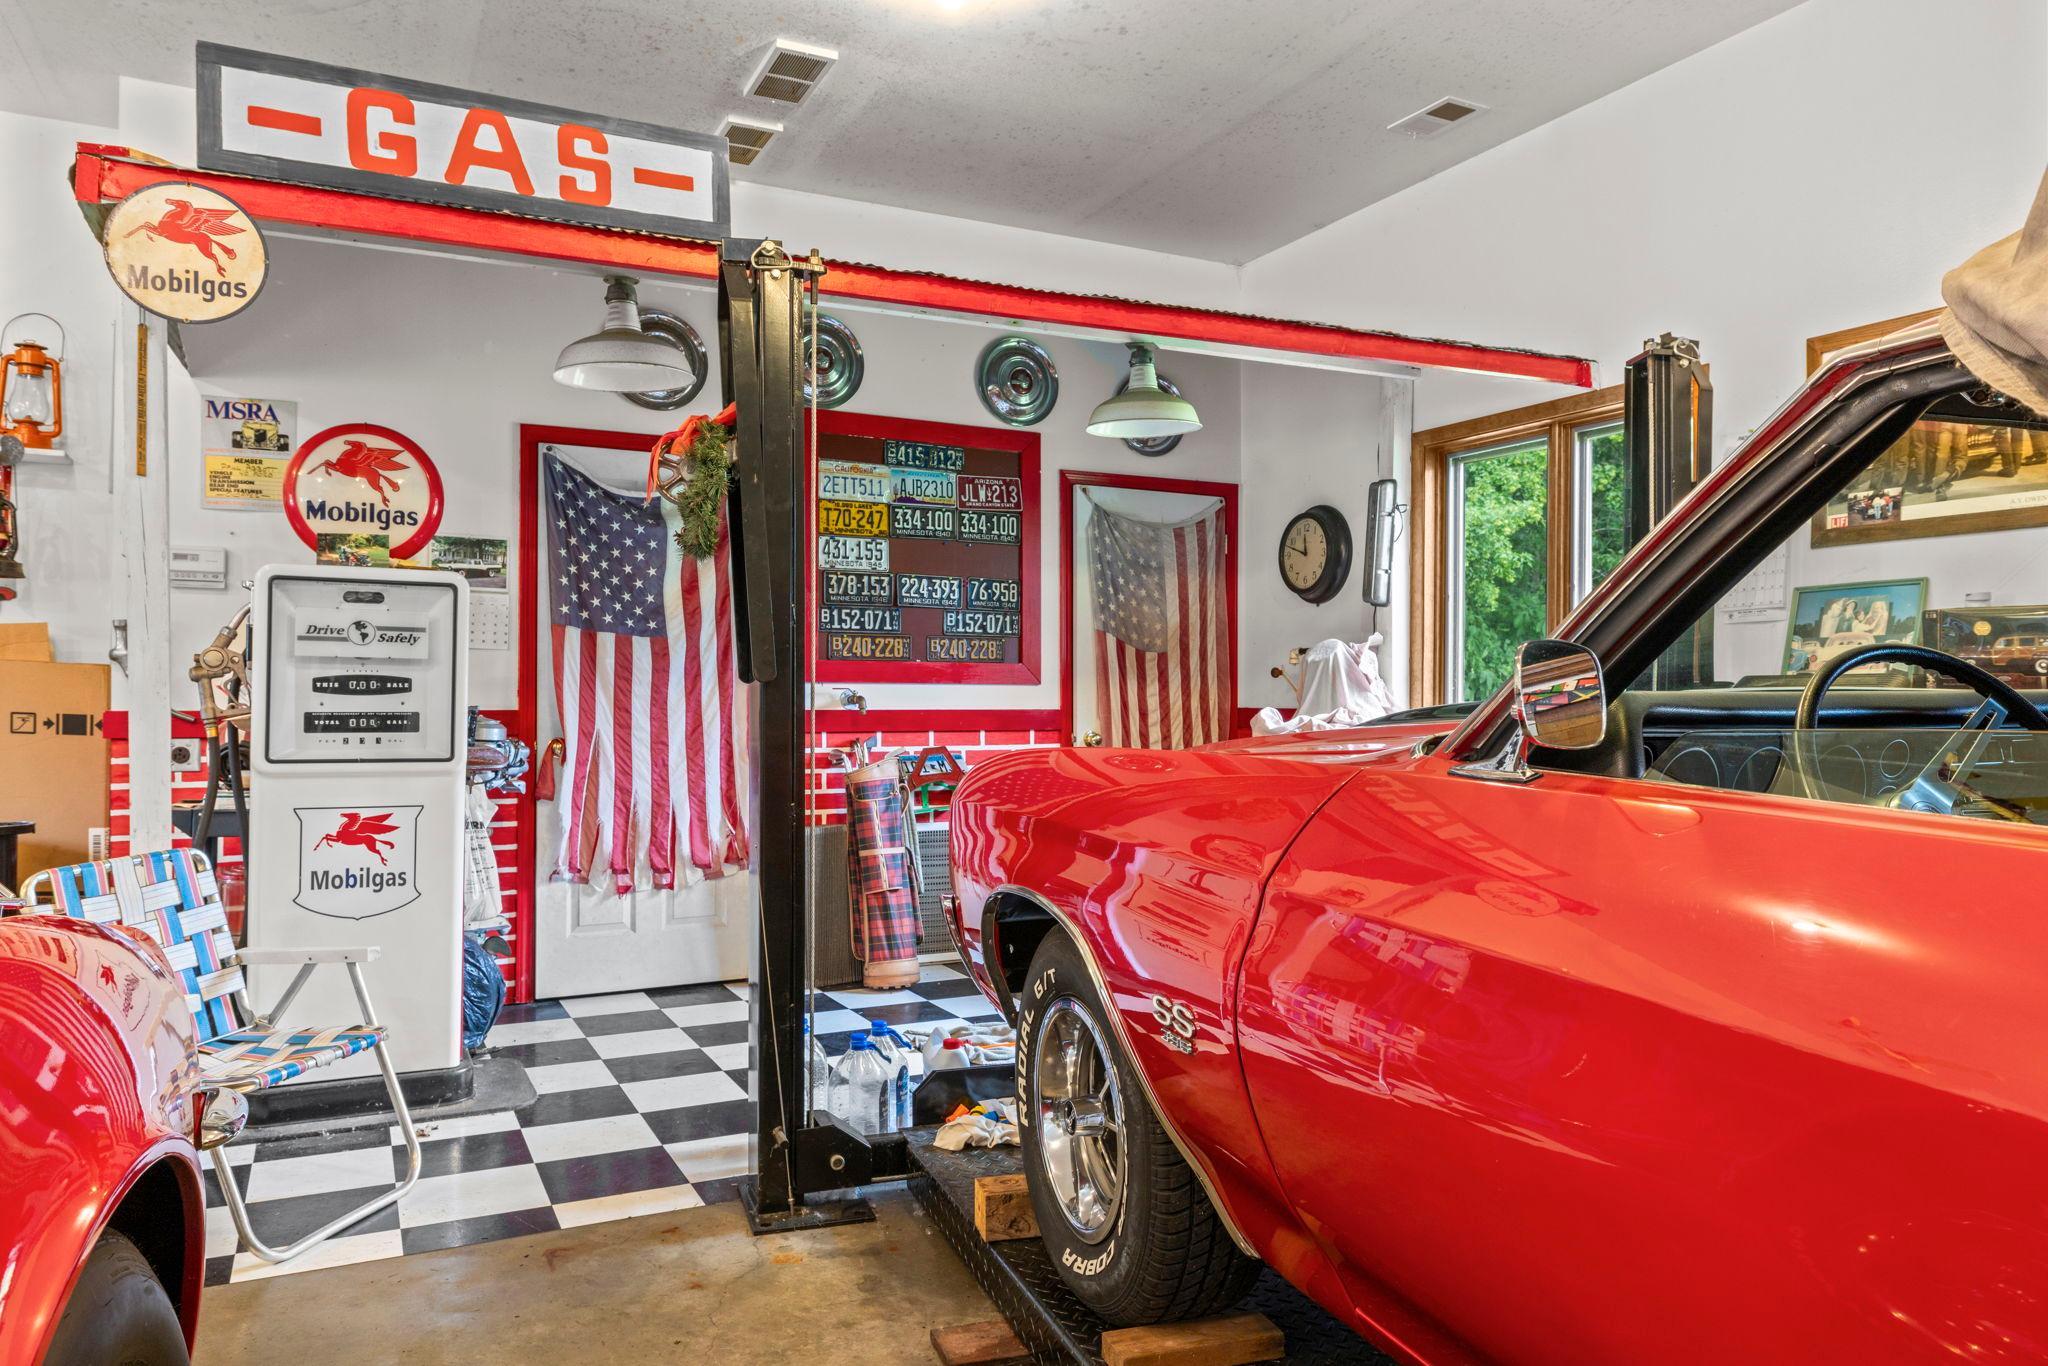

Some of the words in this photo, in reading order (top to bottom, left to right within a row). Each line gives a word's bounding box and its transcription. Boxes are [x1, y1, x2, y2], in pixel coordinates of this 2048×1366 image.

[127, 264, 247, 302] Mobilgas
[205, 400, 280, 423] MSRA
[234, 457, 263, 465] MEMBER
[823, 475, 885, 497] 2ETT511
[900, 478, 954, 499] AJB2310
[974, 478, 1004, 486] ARIZONA
[992, 485, 1018, 503] 213
[306, 500, 418, 530] Mobilgas
[1831, 516, 1849, 529] LIF
[896, 529, 934, 537] MINNESOTA
[962, 533, 999, 541] MINNESOTA
[830, 595, 870, 603] MINNESOTA
[903, 597, 940, 606] MINNESOTA
[305, 624, 346, 636] Drive
[377, 633, 421, 646] Safely
[310, 867, 406, 893] Mobilgas
[1034, 968, 1056, 1000] G/T
[1152, 994, 1194, 1038] SS
[1019, 1007, 1036, 1128] RADIAL
[1062, 1239, 1115, 1276] COBRA
